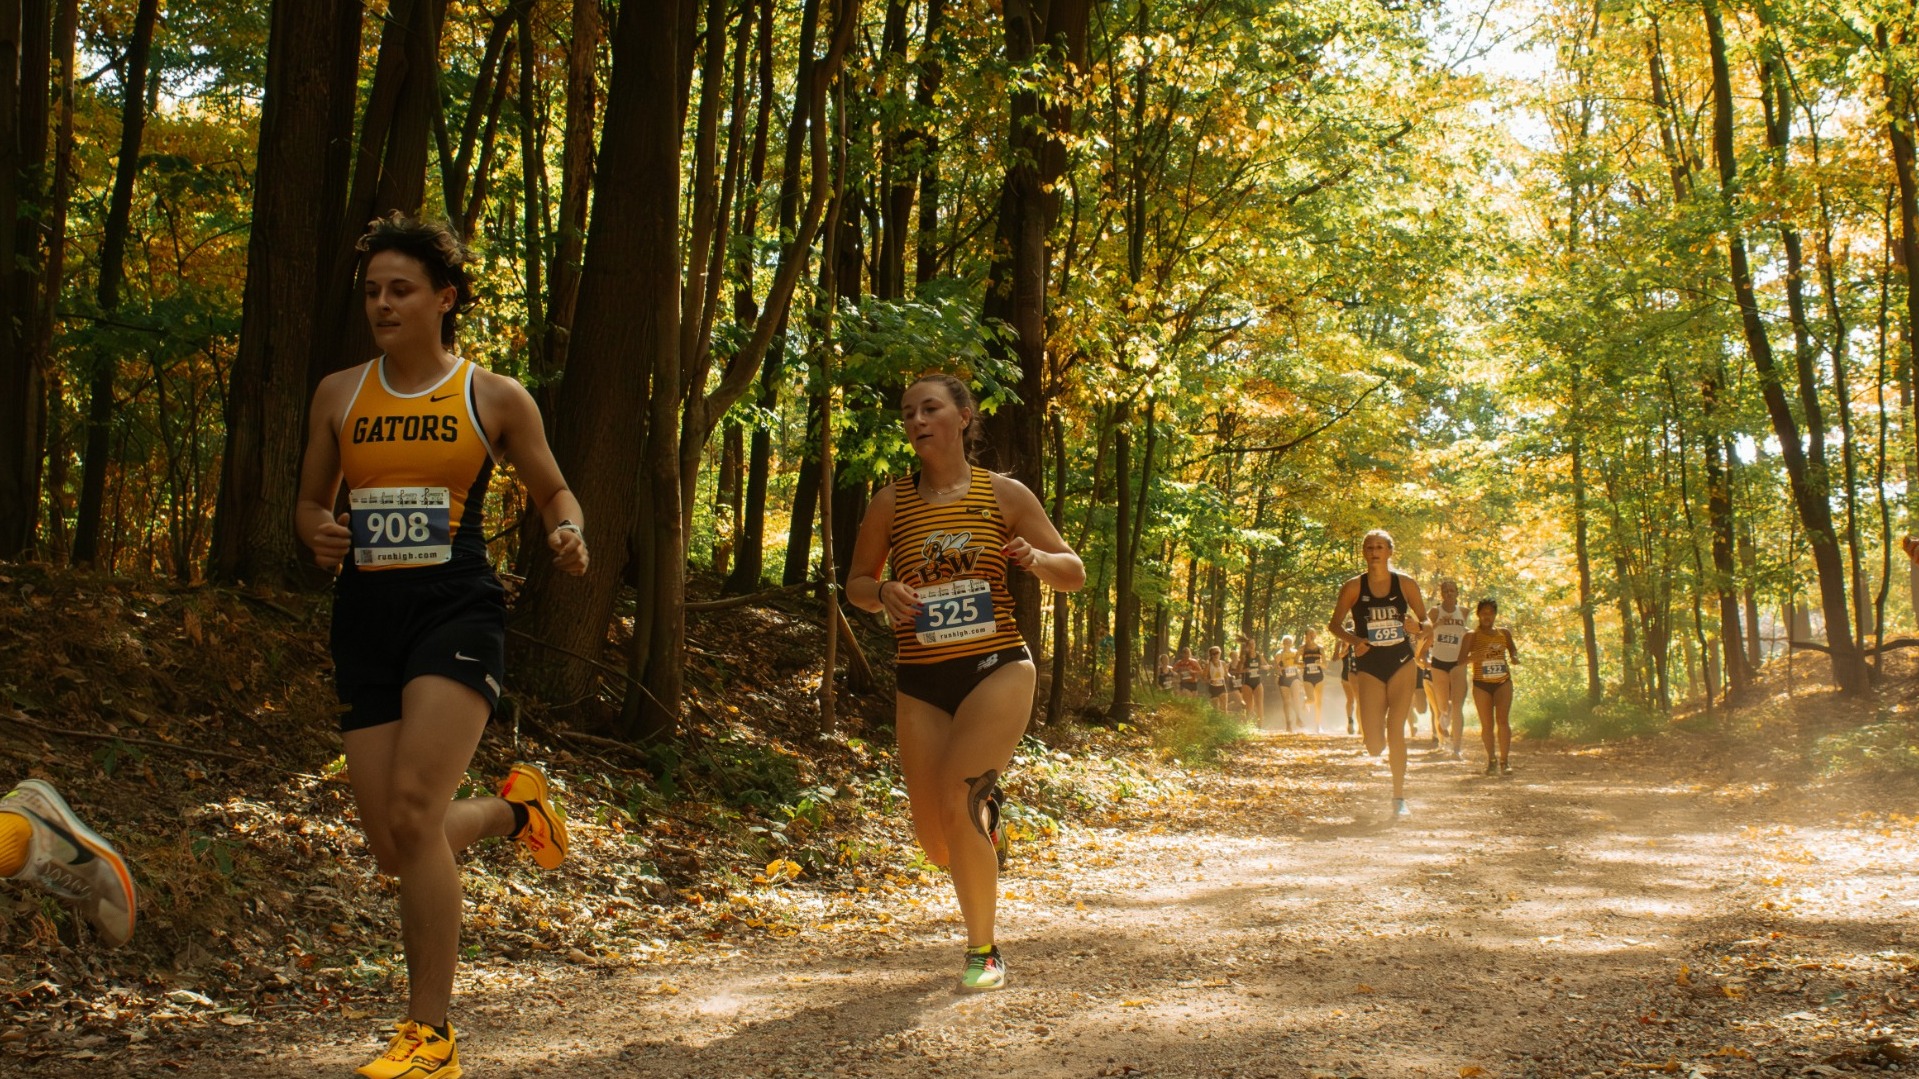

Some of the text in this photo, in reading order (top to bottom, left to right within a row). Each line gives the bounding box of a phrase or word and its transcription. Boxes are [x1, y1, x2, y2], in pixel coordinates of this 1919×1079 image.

[353, 415, 458, 444] GATORS
[367, 511, 430, 544] 908
[377, 551, 437, 561] runhigh.com
[928, 597, 978, 627] 525
[1368, 606, 1399, 620] IUP
[940, 627, 986, 640] runhigh.com
[1375, 628, 1398, 640] 695
[1487, 665, 1503, 674] 522
